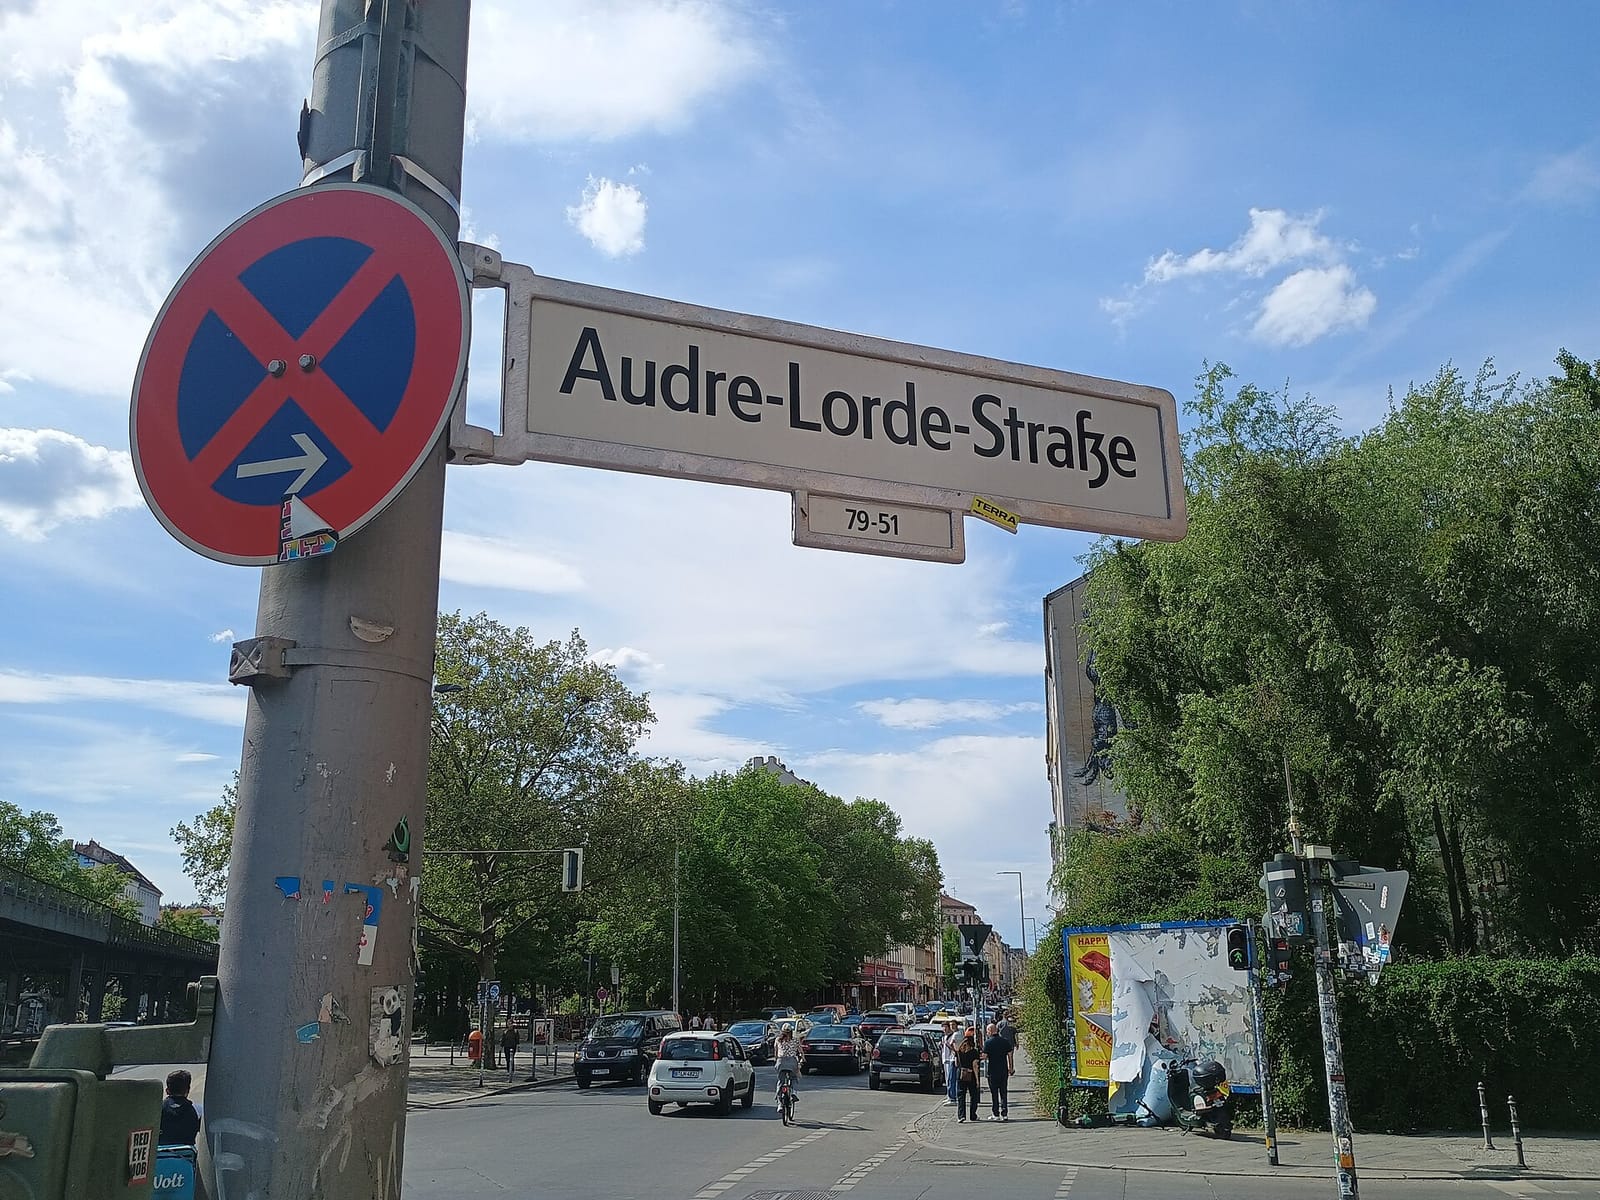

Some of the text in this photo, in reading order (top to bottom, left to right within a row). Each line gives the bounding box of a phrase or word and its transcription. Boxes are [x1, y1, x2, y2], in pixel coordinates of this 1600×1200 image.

[559, 326, 1137, 489] Audre-Lorde-Straße
[845, 508, 899, 535] 79-51
[975, 498, 1016, 525] TERRA
[1078, 936, 1107, 945] HAPPY
[134, 1132, 149, 1147] RED
[132, 1147, 147, 1161] EYE
